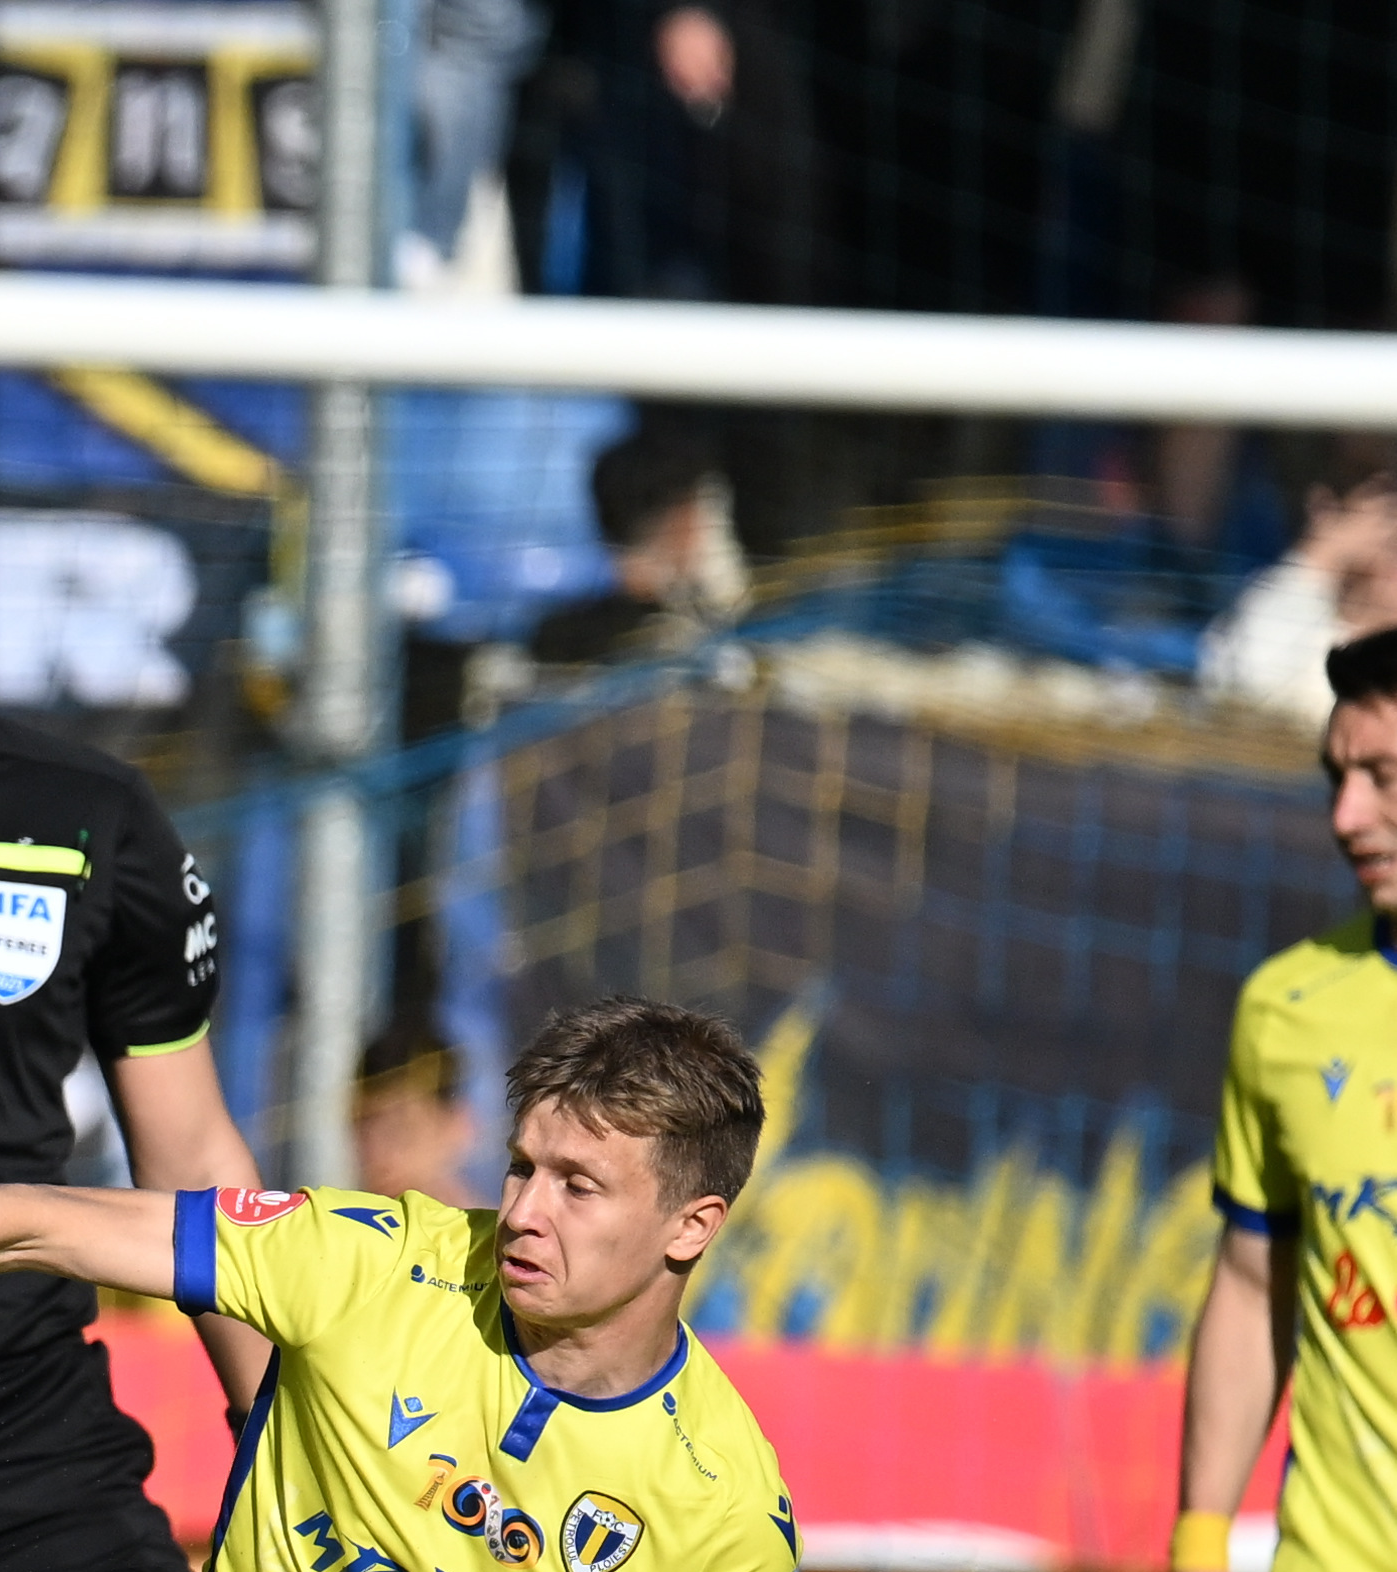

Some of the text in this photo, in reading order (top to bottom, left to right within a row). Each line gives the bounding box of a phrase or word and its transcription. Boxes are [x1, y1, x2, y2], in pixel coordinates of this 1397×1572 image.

[426, 1276, 493, 1293] ACTEMIU
[671, 1417, 719, 1482] ACTEMIUM
[564, 1508, 586, 1566] PETROLUL
